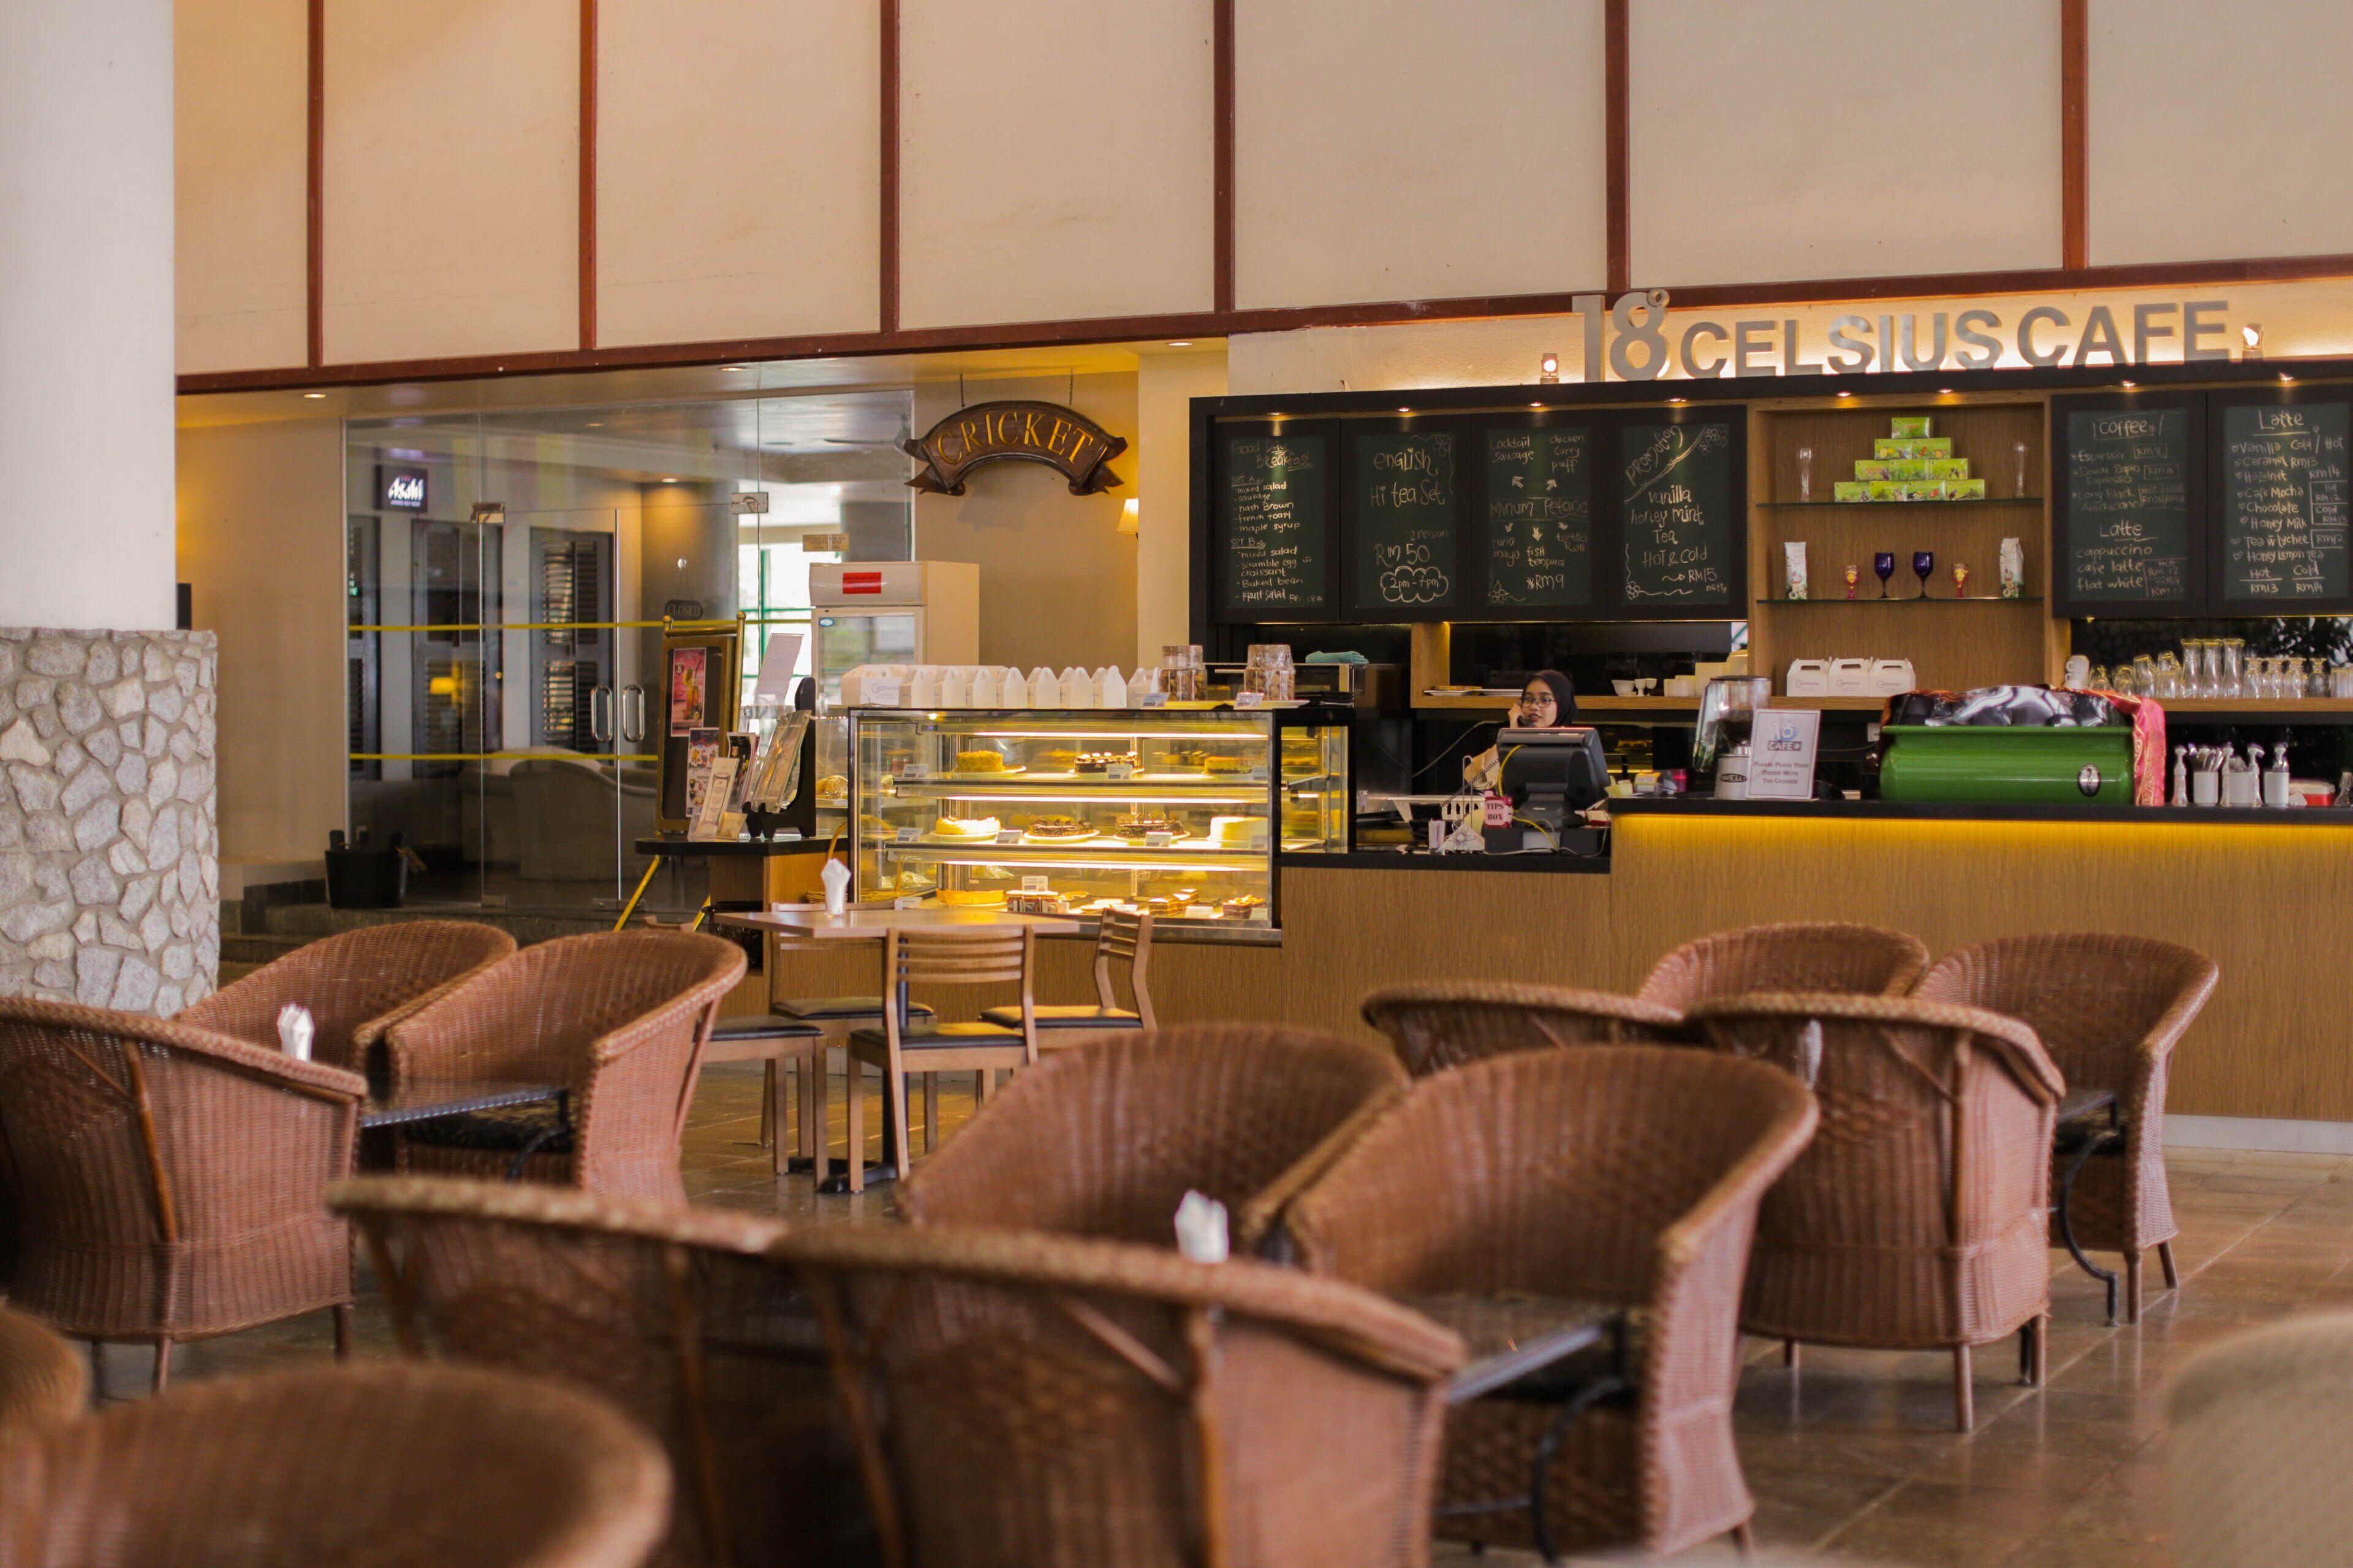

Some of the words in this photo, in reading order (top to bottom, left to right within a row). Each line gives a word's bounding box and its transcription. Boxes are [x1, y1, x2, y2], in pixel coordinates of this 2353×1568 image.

[1680, 308, 2004, 379] CELSIUS
[2017, 300, 2231, 368] CAFE
[2258, 410, 2305, 430] Latte
[937, 411, 1094, 464] CRICKET
[1551, 458, 1579, 474] puff
[2242, 455, 2289, 468] Caramel
[387, 477, 424, 501] Asahi
[1263, 481, 1287, 491] salad
[2270, 483, 2304, 498] Mocha
[1370, 483, 1387, 507] Hi
[1390, 482, 1417, 508] tea
[2246, 501, 2300, 514] Chocolate
[1267, 510, 1291, 521] toast
[1630, 508, 1668, 528] honey
[1672, 504, 1705, 526] mint
[1240, 523, 1268, 534] maple
[1273, 522, 1301, 533] syrup
[2100, 519, 2143, 537] Latte
[2251, 517, 2283, 532] Honey
[2286, 517, 2308, 529] Milk
[1248, 537, 1256, 547] B
[1410, 530, 1416, 541] 2
[1652, 529, 1679, 545] Tea
[2243, 535, 2265, 549] Tea
[1271, 545, 1298, 557] salad
[1405, 542, 1431, 566] 50
[2246, 550, 2276, 564] Honey
[1241, 559, 1279, 570] scramble
[1493, 550, 1520, 567] mayo
[1527, 557, 1565, 570] tempura
[1667, 551, 1680, 567] &
[2111, 559, 2143, 573] latte
[2249, 566, 2272, 579] Hot
[1277, 577, 1303, 586] bean
[2107, 575, 2144, 589] white
[667, 604, 700, 617] CLOSED
[1768, 741, 1793, 750] CAFE
